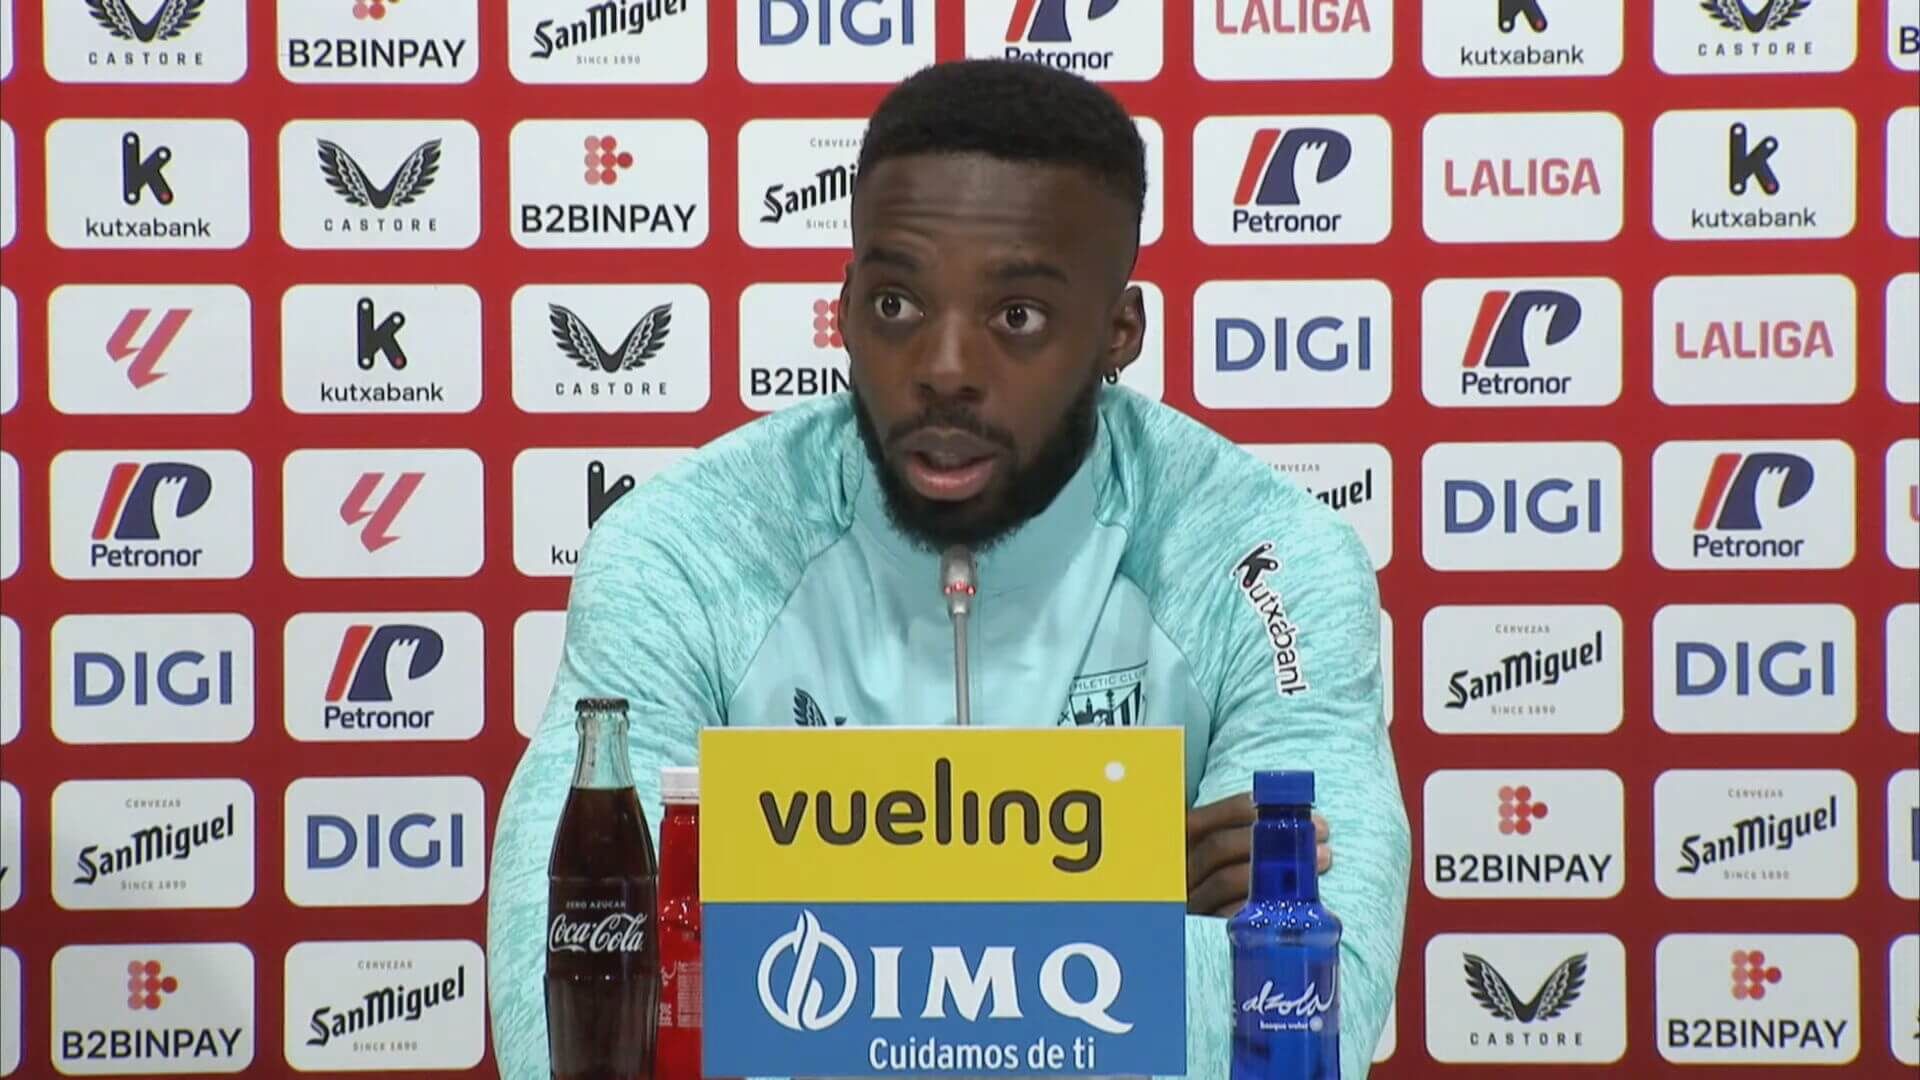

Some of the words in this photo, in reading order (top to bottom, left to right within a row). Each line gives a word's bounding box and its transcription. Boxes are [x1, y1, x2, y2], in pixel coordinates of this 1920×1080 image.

[759, 0, 914, 46] DIGI
[1216, 0, 1370, 34] LALIGA
[89, 52, 201, 65] CASTORE
[289, 39, 465, 67] B2BINPAY
[1461, 45, 1583, 65] kutxabank
[1698, 42, 1811, 56] CASTORE
[1445, 158, 1600, 197] LALIGA
[86, 218, 210, 236] kutxabank
[325, 219, 436, 231] CASTORE
[522, 205, 696, 232] B2BINPAY
[1233, 210, 1341, 232] Petronor
[1692, 208, 1816, 227] kutxabank
[1216, 317, 1370, 372] DIGI
[1676, 320, 1833, 359] LALIGA
[321, 383, 443, 401] kutxabank
[556, 383, 665, 395] CASTORE
[1462, 372, 1571, 394] Petronor
[1445, 479, 1600, 533] DIGI
[92, 544, 202, 567] Petronor
[1693, 535, 1804, 557] Petronor
[74, 651, 232, 706] DIGI
[1676, 641, 1834, 696] DIGI
[325, 706, 434, 728] Petronor
[760, 758, 1102, 873] vueling
[307, 813, 463, 869] DIGI
[1436, 854, 1611, 882] B2BINPAY
[871, 943, 1133, 1034] IMQ
[63, 1028, 242, 1059] B2BINPAY
[1470, 1032, 1581, 1045] CASTORE
[1669, 1019, 1846, 1048] B2BINPAY
[868, 1037, 1020, 1069] Cuidamos
[1027, 1037, 1064, 1069] de
[1073, 1037, 1096, 1069] ti
